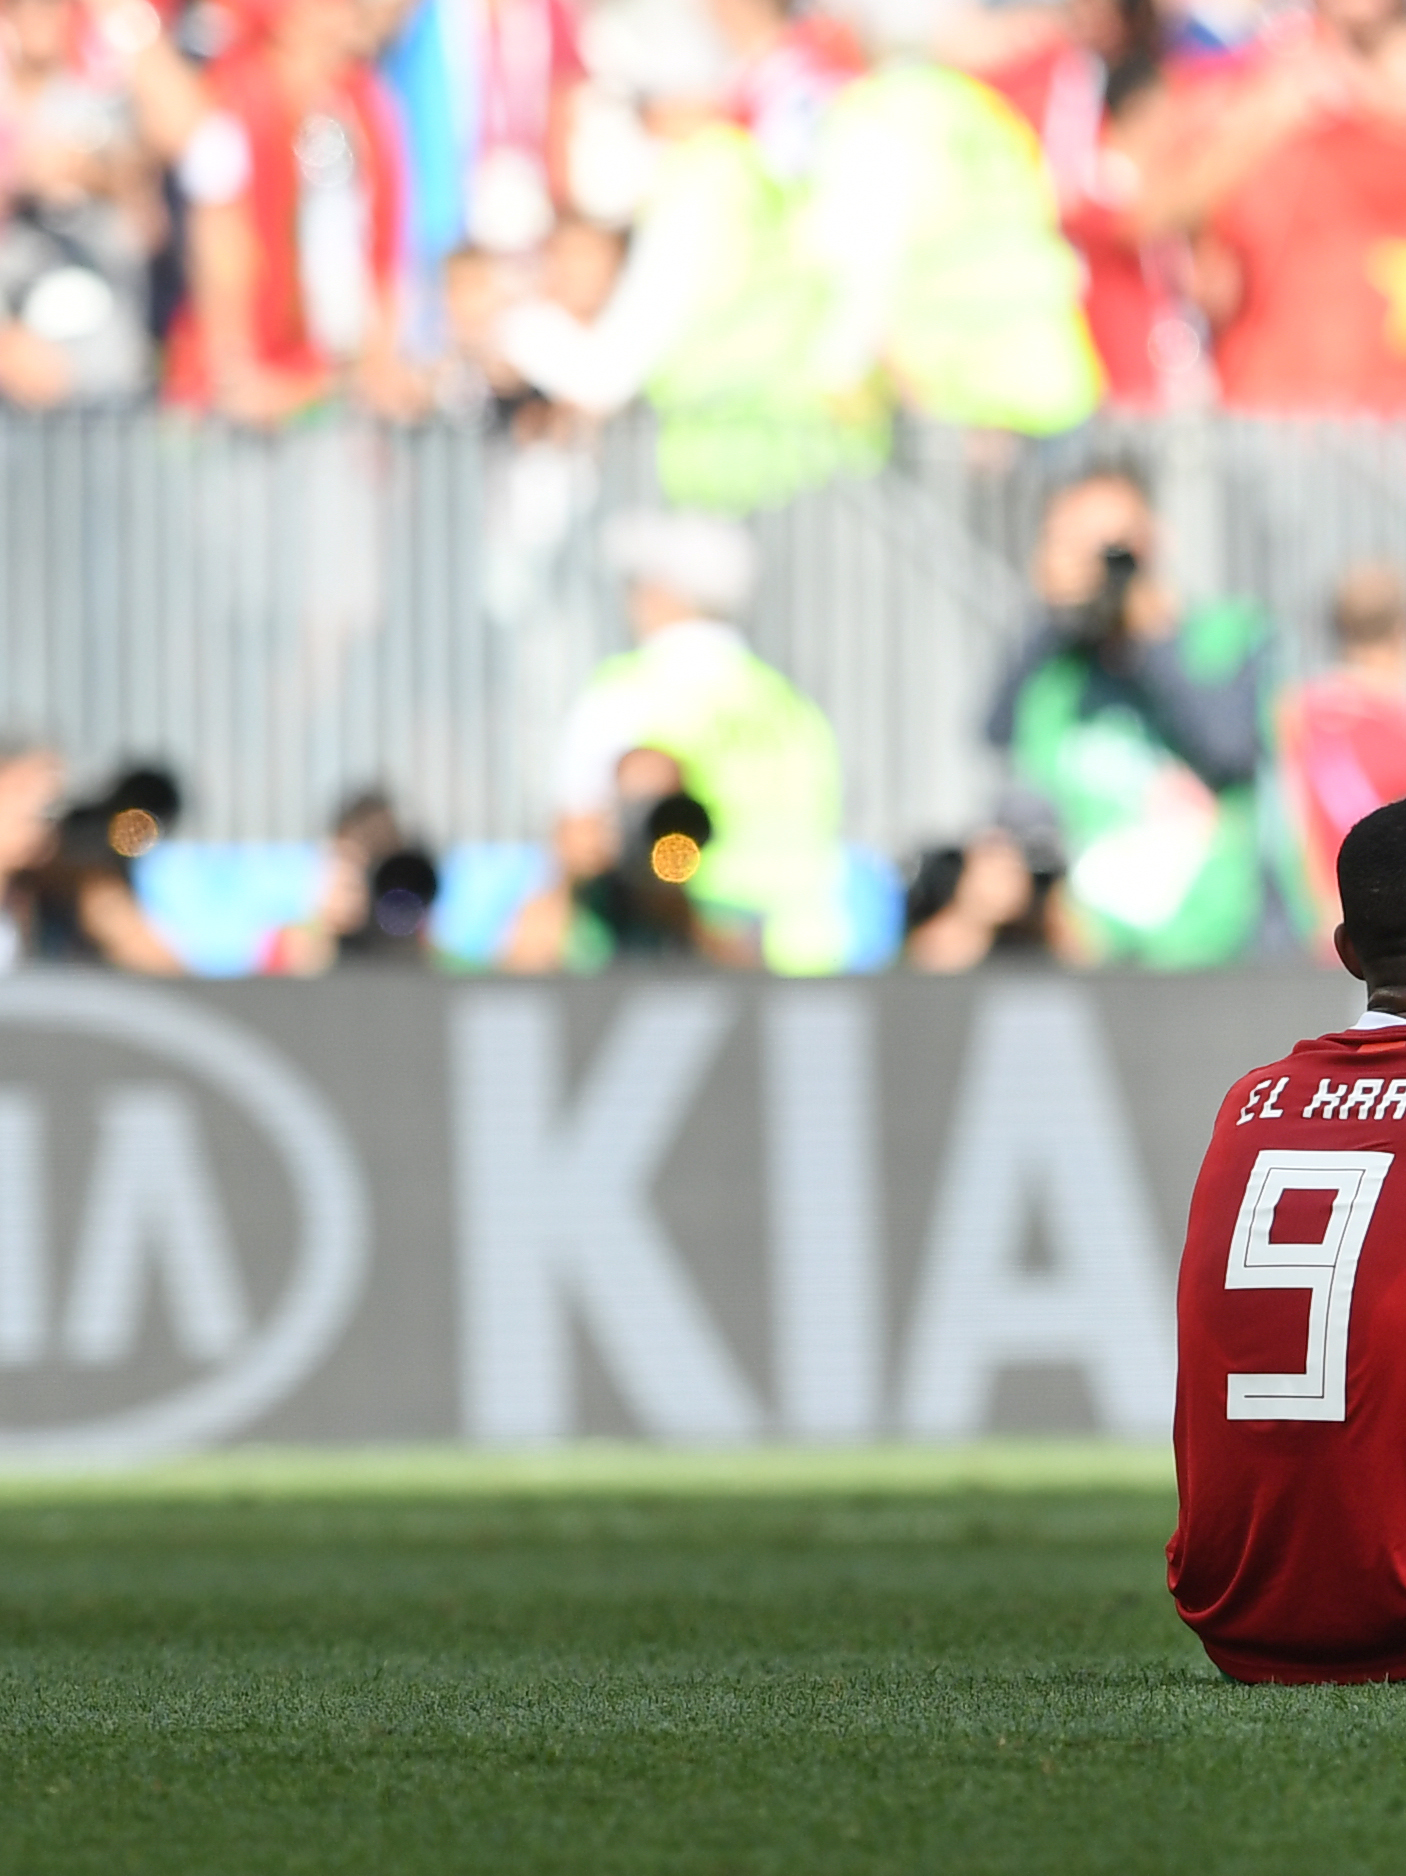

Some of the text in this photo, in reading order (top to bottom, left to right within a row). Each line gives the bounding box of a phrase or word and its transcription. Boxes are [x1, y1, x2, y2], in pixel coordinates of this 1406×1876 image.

[452, 985, 1178, 1446] KIA
[1236, 1076, 1290, 1126] EL
[1224, 1150, 1396, 1422] 9
